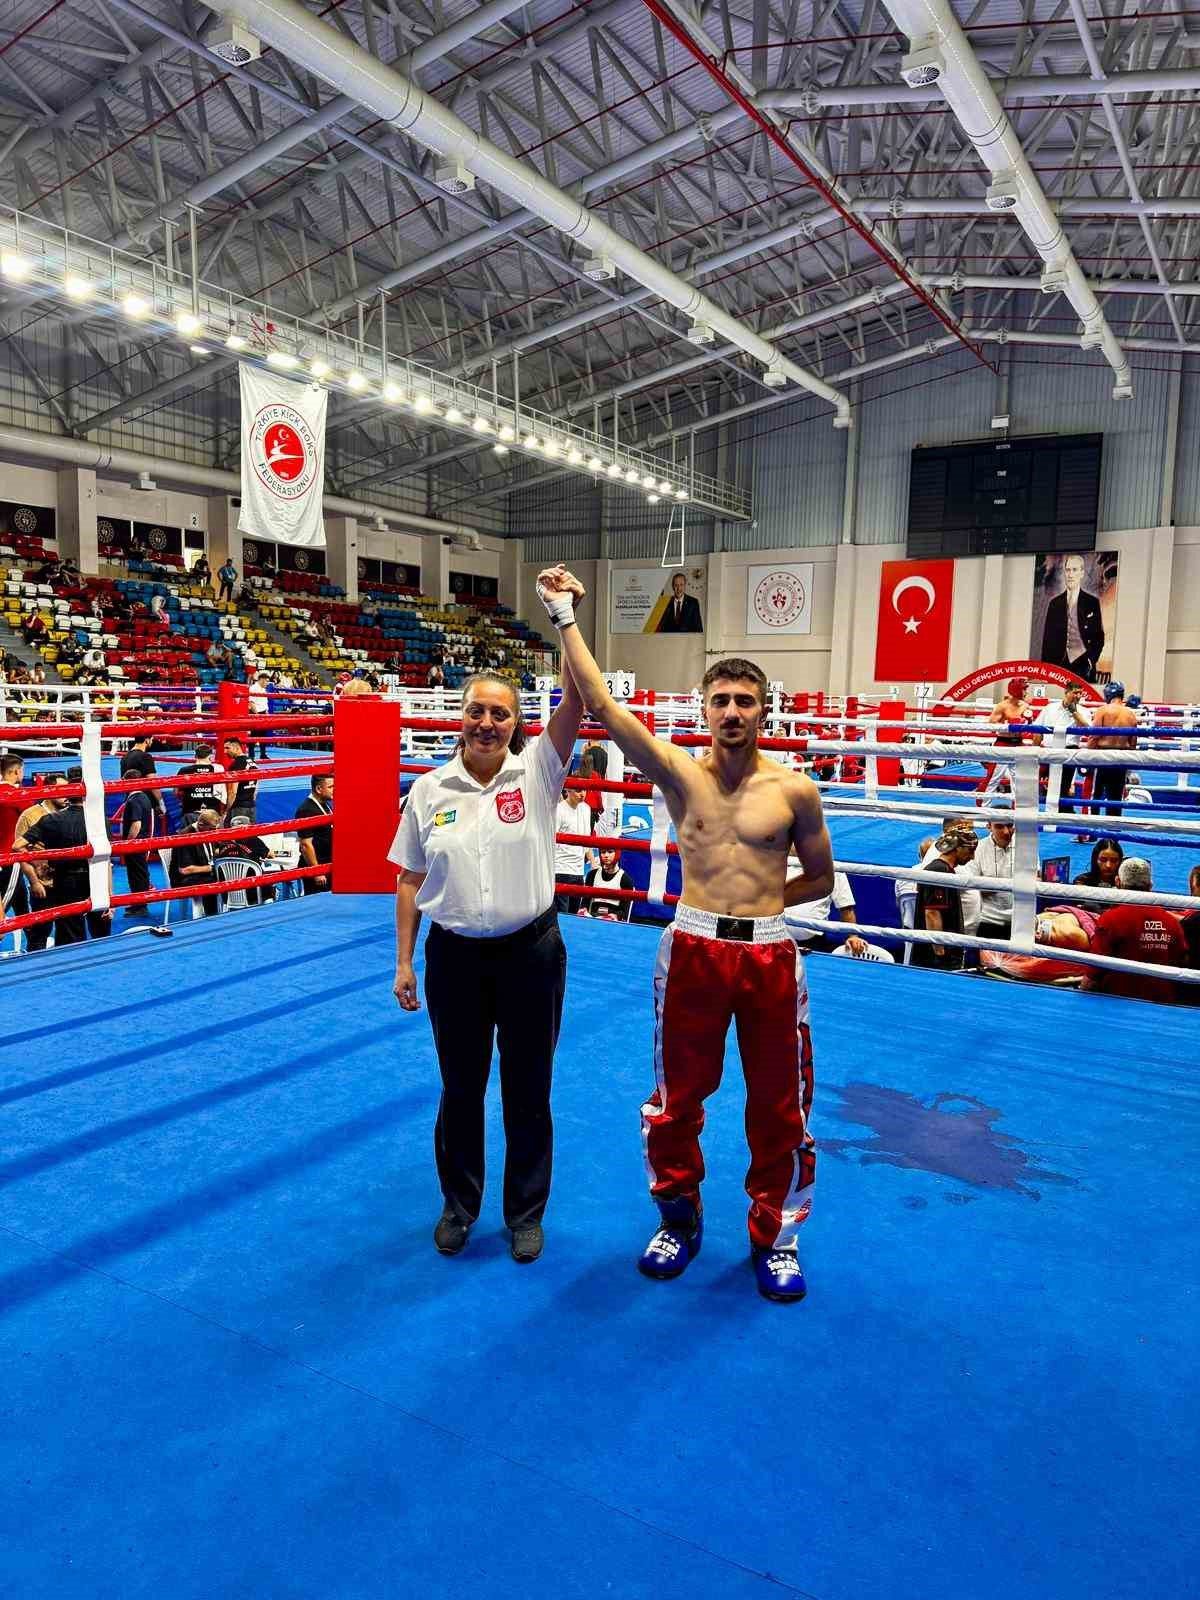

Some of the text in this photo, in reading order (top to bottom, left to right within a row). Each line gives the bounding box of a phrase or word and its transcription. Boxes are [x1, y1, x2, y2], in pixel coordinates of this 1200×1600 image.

[258, 462, 310, 496] FEDERASYONU
[1005, 665, 1016, 673] VE
[1017, 665, 1040, 674] SPOR
[539, 680, 545, 690] 2
[606, 680, 613, 695] 3
[622, 681, 630, 696] 3
[923, 687, 930, 697] 7
